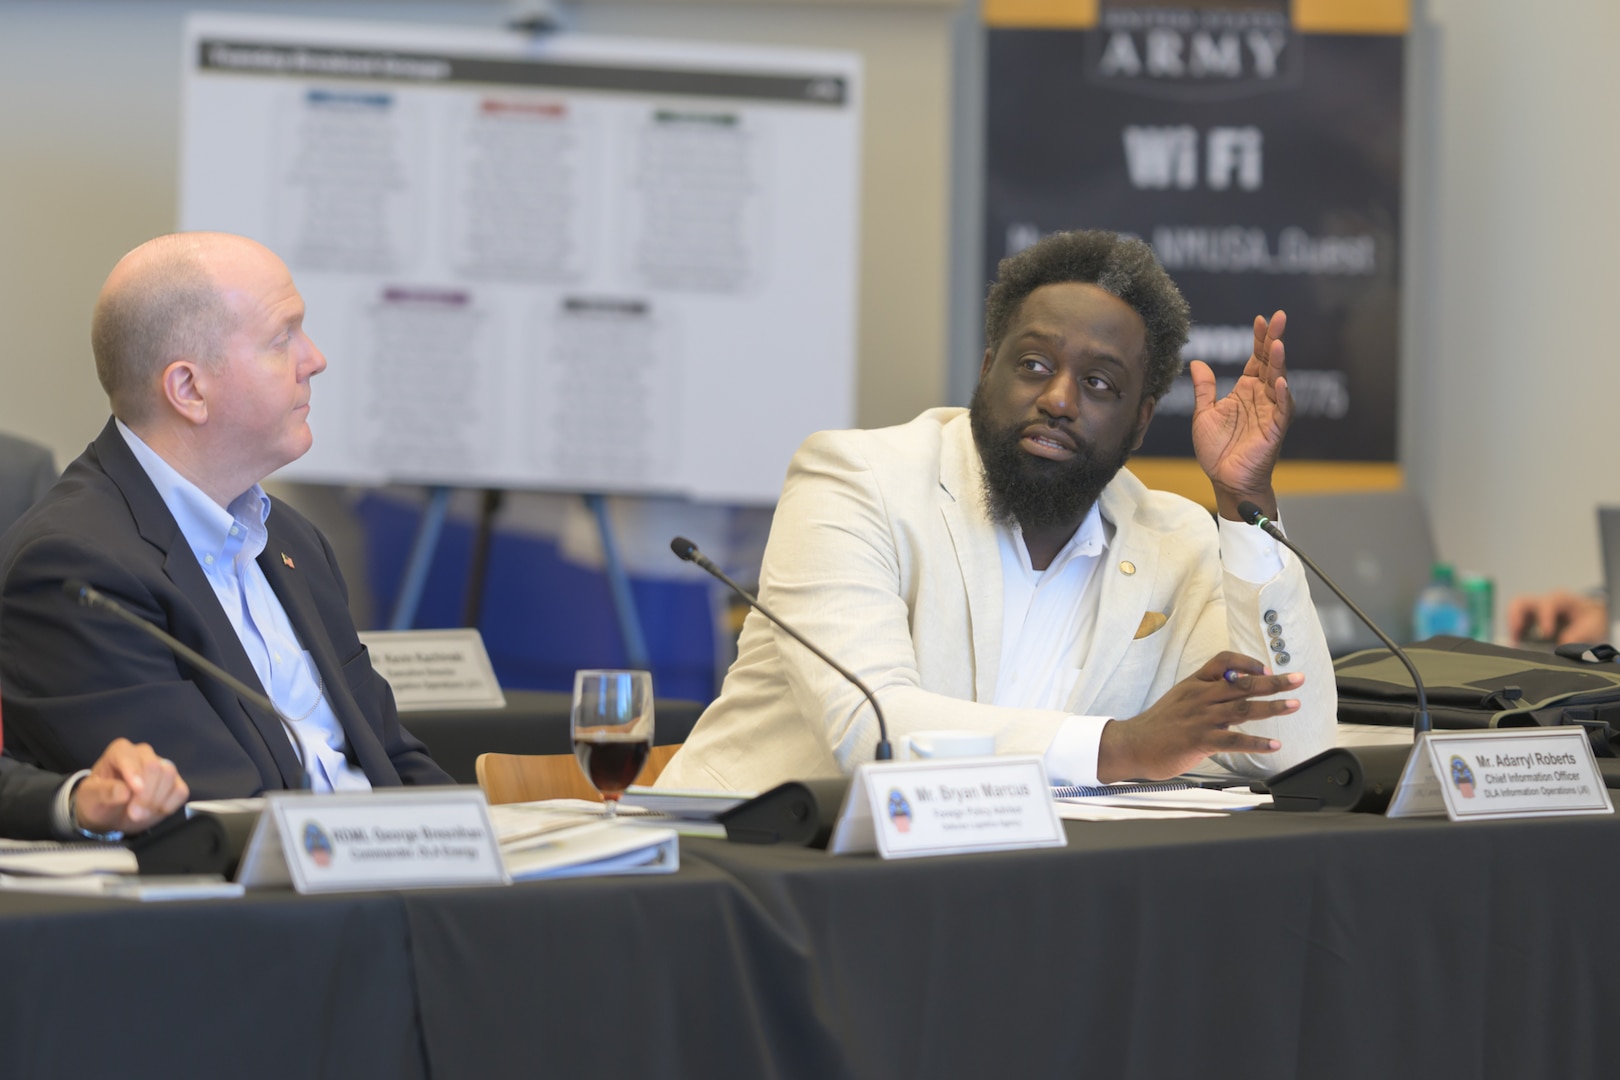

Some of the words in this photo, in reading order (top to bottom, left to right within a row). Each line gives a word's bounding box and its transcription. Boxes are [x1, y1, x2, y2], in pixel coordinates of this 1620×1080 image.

[1099, 29, 1286, 78] ARMY
[1122, 124, 1198, 189] Wi
[1206, 125, 1264, 190] Fi
[1476, 754, 1496, 767] Mr.
[1496, 753, 1535, 769] Adarryl
[1535, 752, 1577, 766] Roberts
[1485, 772, 1507, 784] Chief
[1507, 771, 1553, 783] Information
[1554, 770, 1580, 781] Officer
[915, 786, 938, 802] Mr.
[939, 784, 979, 804] Bryan
[980, 782, 1031, 798] Marcus
[1484, 789, 1501, 798] DLA
[1501, 787, 1539, 797] Information
[1540, 786, 1577, 797] Operations
